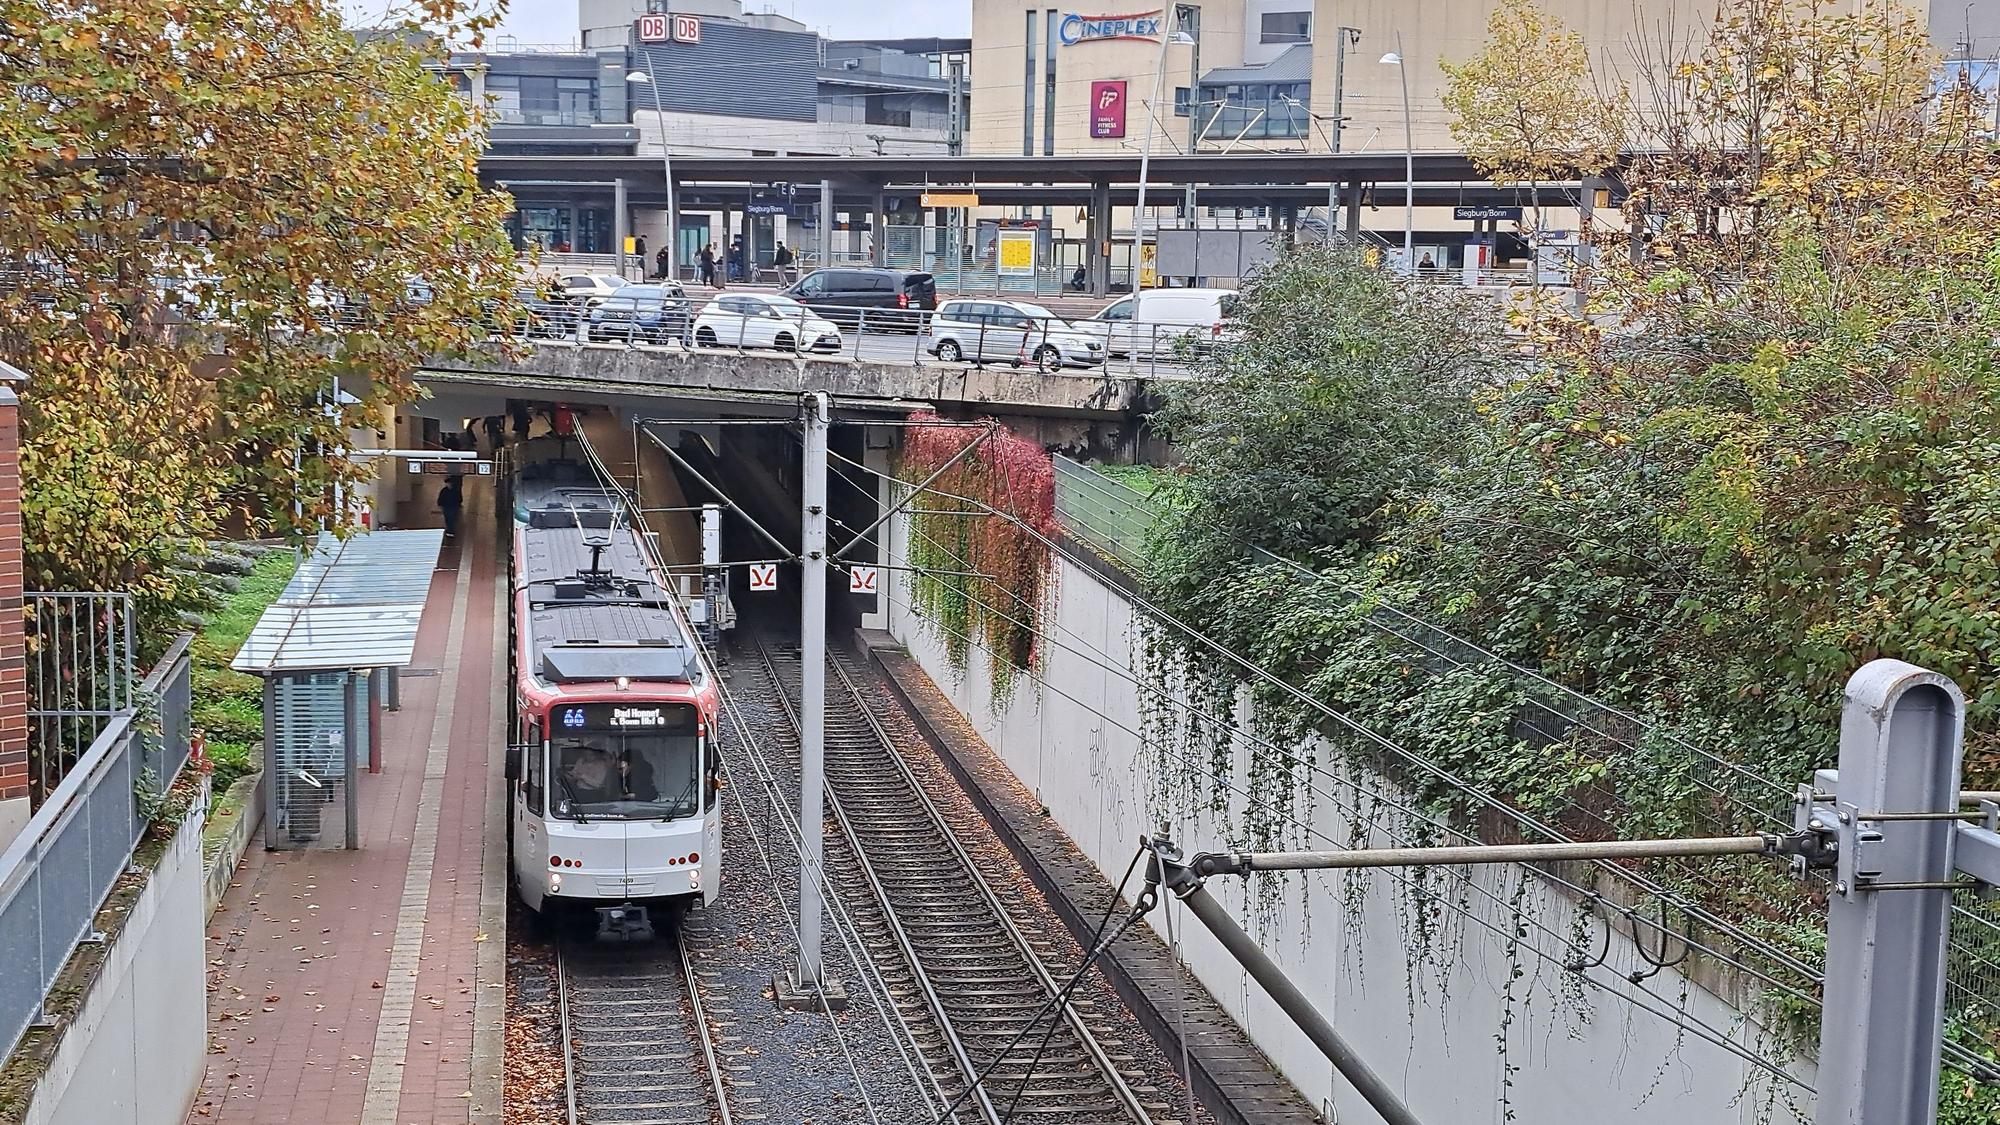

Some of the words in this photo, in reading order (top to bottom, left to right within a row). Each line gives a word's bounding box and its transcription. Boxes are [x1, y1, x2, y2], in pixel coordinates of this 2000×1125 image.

[643, 19, 664, 37] DB
[679, 19, 697, 38] DB
[1060, 14, 1160, 45] CINEPLEX
[790, 183, 796, 196] 6
[1457, 209, 1507, 219] Siegburg/Bonn
[564, 709, 584, 726] 66
[614, 708, 631, 718] Bad
[631, 708, 660, 718] Honnef
[619, 717, 640, 725] Bonn
[559, 800, 568, 814] 4
